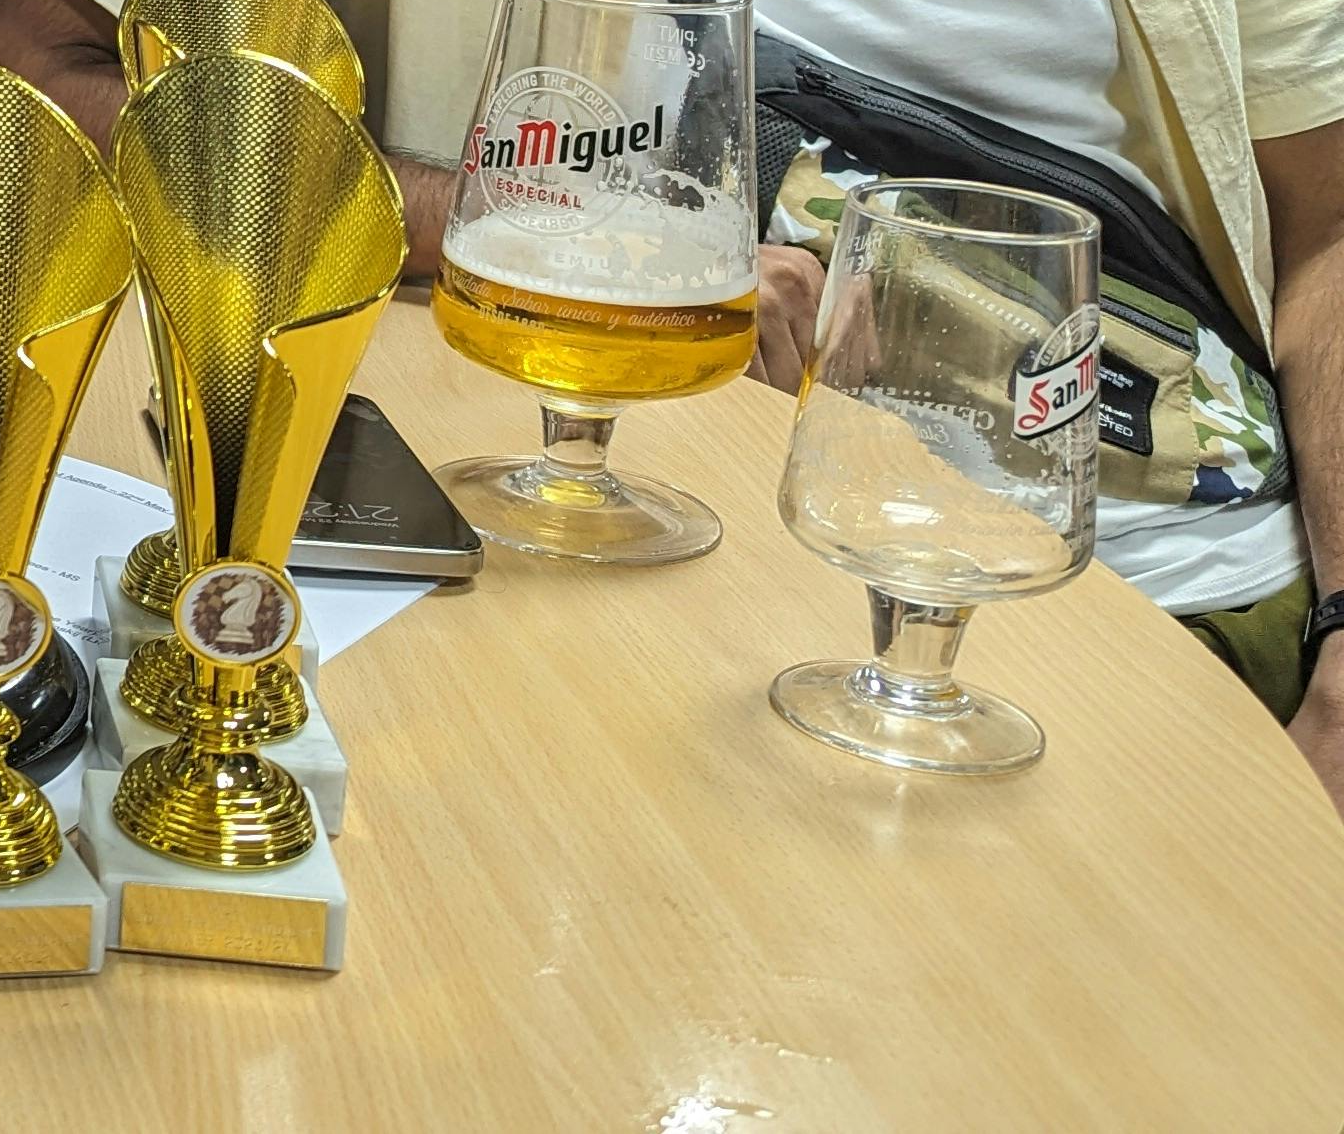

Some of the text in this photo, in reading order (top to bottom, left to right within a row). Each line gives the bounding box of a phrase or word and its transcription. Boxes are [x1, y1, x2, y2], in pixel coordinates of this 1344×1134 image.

[488, 72, 617, 124] EXPLORING THE WORLD
[495, 176, 584, 210] ESPECIAL
[501, 288, 551, 315] Sabor
[608, 313, 620, 331] y
[303, 500, 399, 523] 21:2
